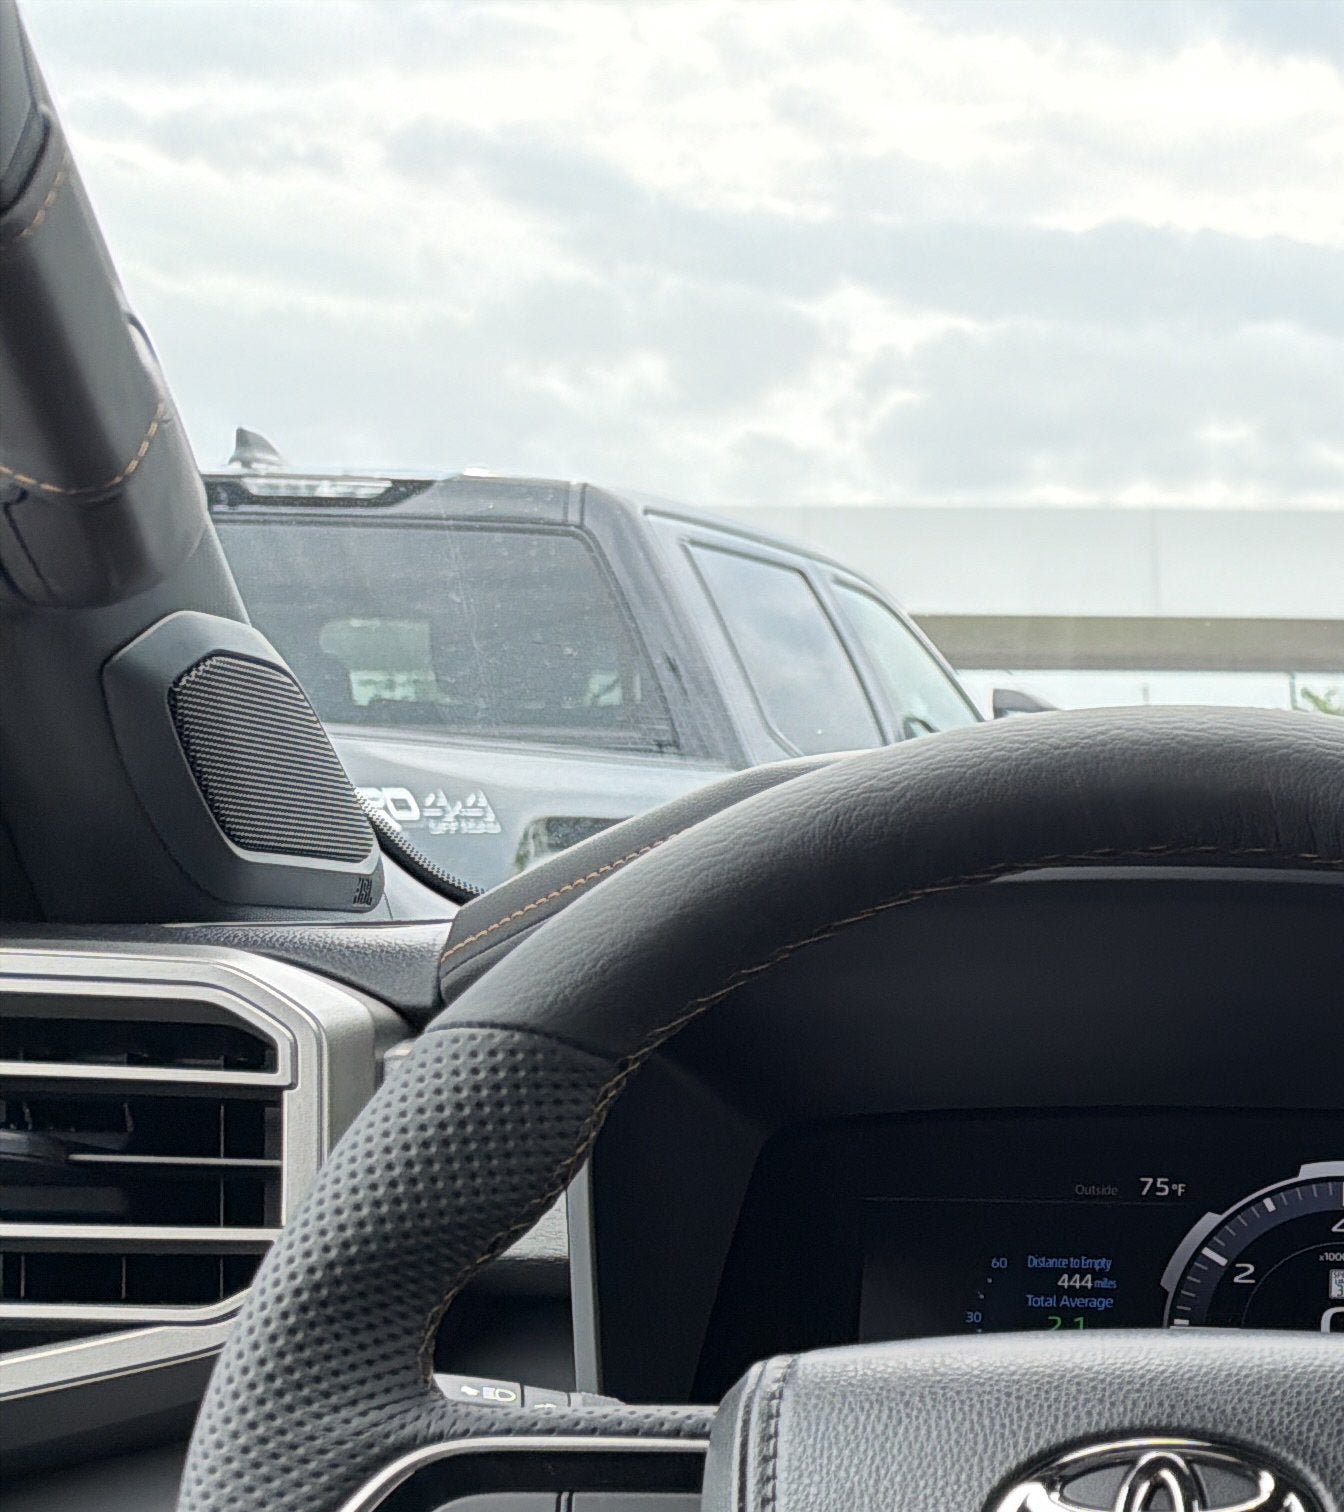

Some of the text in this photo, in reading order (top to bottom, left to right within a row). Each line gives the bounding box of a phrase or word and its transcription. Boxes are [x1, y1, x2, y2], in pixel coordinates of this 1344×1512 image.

[1074, 1184, 1119, 1196] Outside
[991, 1257, 1008, 1269] 60
[1027, 1254, 1112, 1271] Distance to Empty
[1057, 1273, 1117, 1290] 444 miles
[1232, 1263, 1256, 1284] 2
[1026, 1294, 1114, 1311] Total Average
[966, 1312, 982, 1323] 30
[1047, 1315, 1085, 1331] 21
